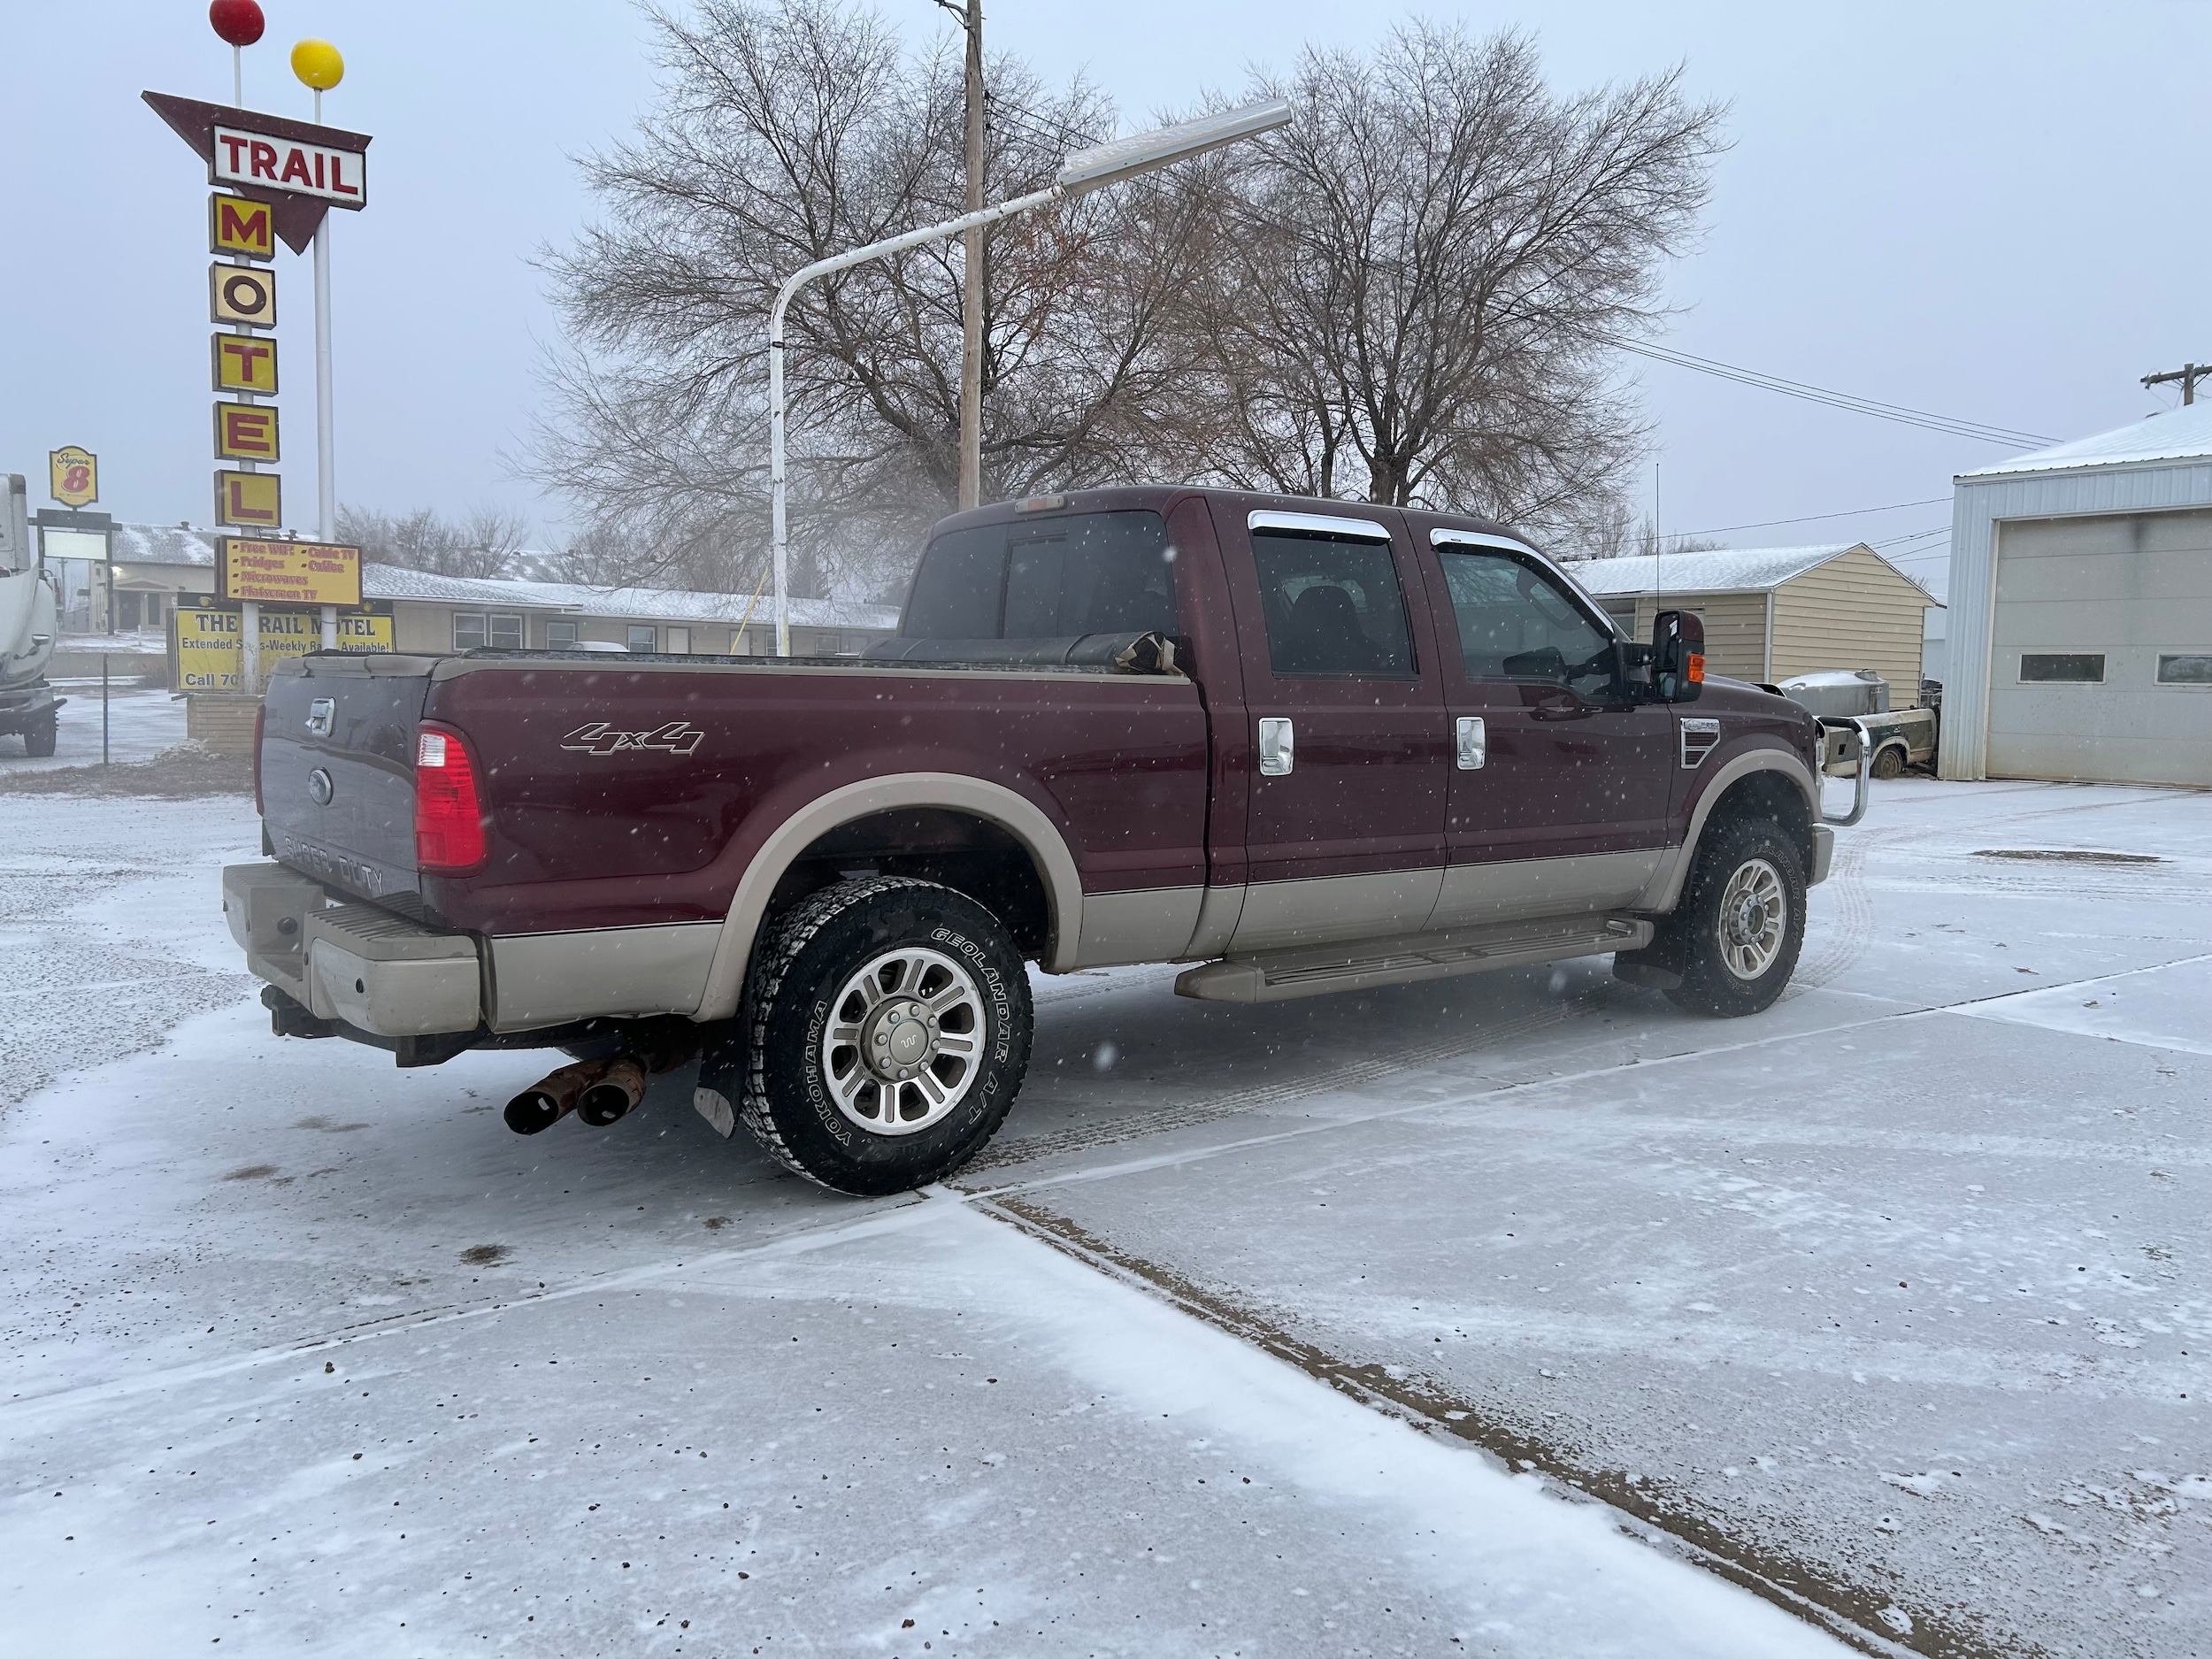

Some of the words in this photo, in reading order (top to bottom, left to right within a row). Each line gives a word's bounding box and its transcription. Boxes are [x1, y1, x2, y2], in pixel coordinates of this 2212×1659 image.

[219, 134, 358, 196] TRAIL
[221, 204, 273, 520] MOTEL
[57, 452, 90, 470] Super
[61, 465, 90, 493] 8
[240, 541, 265, 554] Free
[307, 547, 340, 560] Cable
[340, 549, 356, 561] TV
[240, 556, 285, 571] Fridges
[308, 559, 344, 573] Coffee
[240, 571, 309, 586] Microwaves
[240, 585, 301, 600] Flatscreen
[302, 588, 318, 601] TV
[196, 614, 238, 632] THE
[258, 616, 303, 634] RAIL
[310, 618, 376, 636] MTEL
[182, 637, 233, 649] Extended
[341, 641, 389, 653] Available!
[185, 672, 214, 686] Call
[560, 721, 705, 756] 4x4
[285, 835, 333, 874] SUPER
[339, 855, 383, 895] DUTY
[931, 927, 1011, 1064] GEOLANDAR
[804, 1000, 852, 1147] YOKOHAMA
[967, 1071, 999, 1125] A/T
